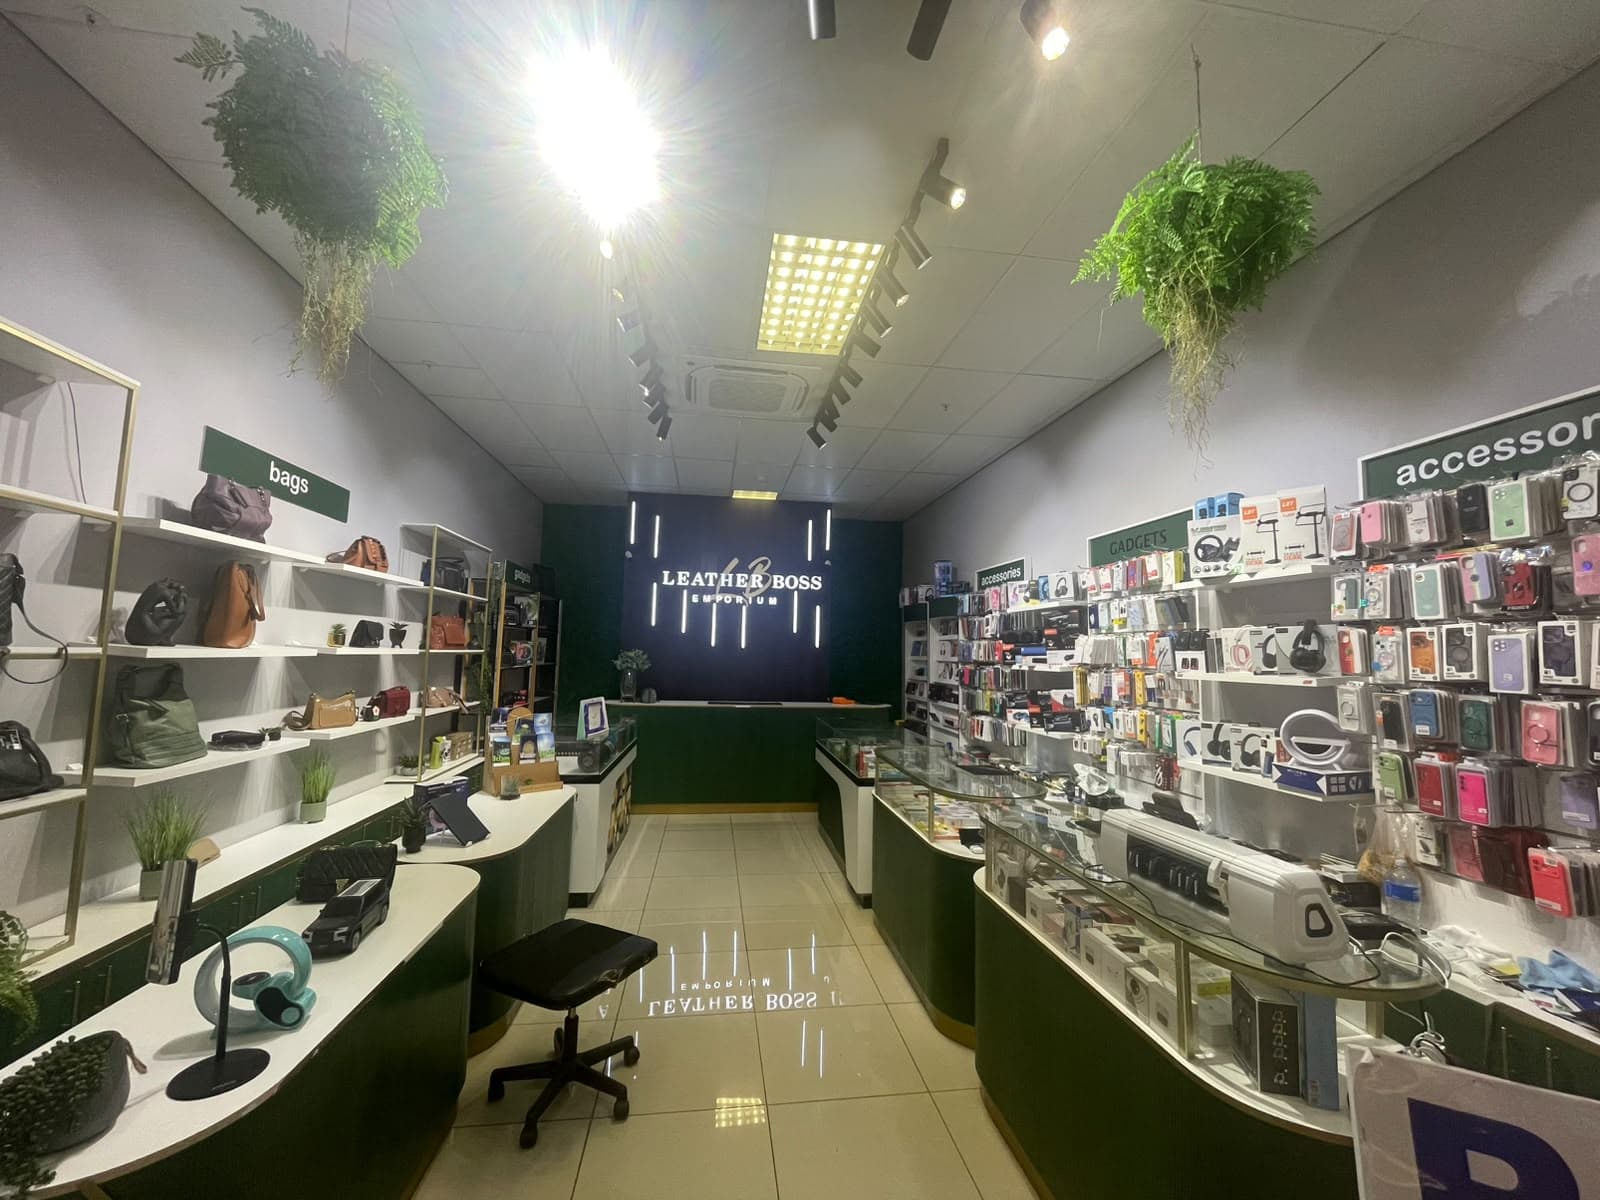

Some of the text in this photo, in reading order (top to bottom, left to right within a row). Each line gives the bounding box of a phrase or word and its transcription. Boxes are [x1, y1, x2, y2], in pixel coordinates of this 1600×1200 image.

[269, 460, 309, 495] bags
[1109, 529, 1168, 556] GADGETS
[661, 570, 823, 590] LEATHER BOSS
[981, 565, 1022, 587] accessories
[691, 593, 778, 605] EMPORIUM
